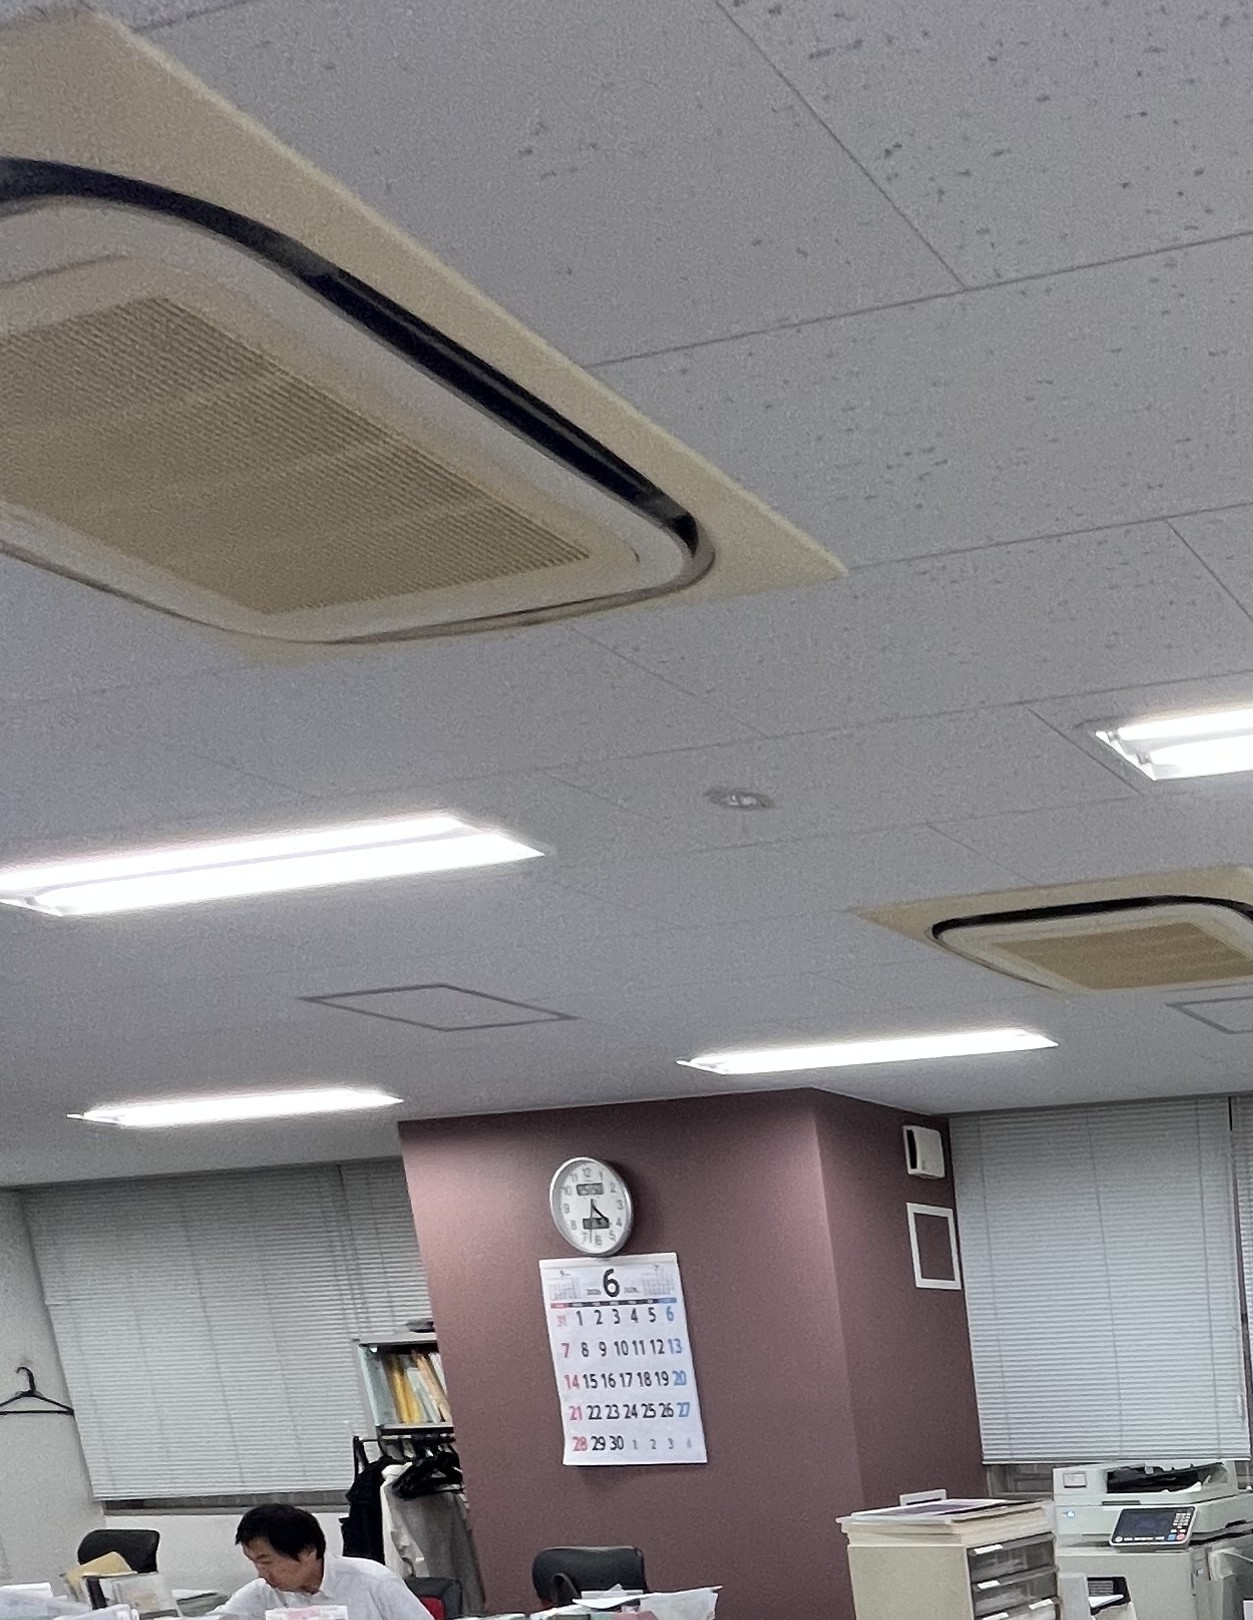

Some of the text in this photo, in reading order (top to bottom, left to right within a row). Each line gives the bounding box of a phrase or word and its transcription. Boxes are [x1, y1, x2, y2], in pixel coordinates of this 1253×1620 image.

[602, 1268, 620, 1298] 6
[576, 1310, 584, 1326] 1
[594, 1309, 603, 1325] 2
[612, 1308, 621, 1324] 3
[630, 1307, 639, 1323] 4
[648, 1306, 657, 1322] 5
[666, 1306, 674, 1321] 6
[561, 1338, 683, 1358] 7 8 9 10 11 12 13
[564, 1370, 687, 1389] 14 15 16 17 18 19 20
[569, 1402, 690, 1420] 21 22 23 24 25 26 27
[572, 1436, 588, 1451] 28
[590, 1436, 606, 1451] 29
[609, 1435, 624, 1450] 30
[632, 1439, 638, 1450] 1
[650, 1438, 657, 1450] 2
[668, 1438, 674, 1449] 3
